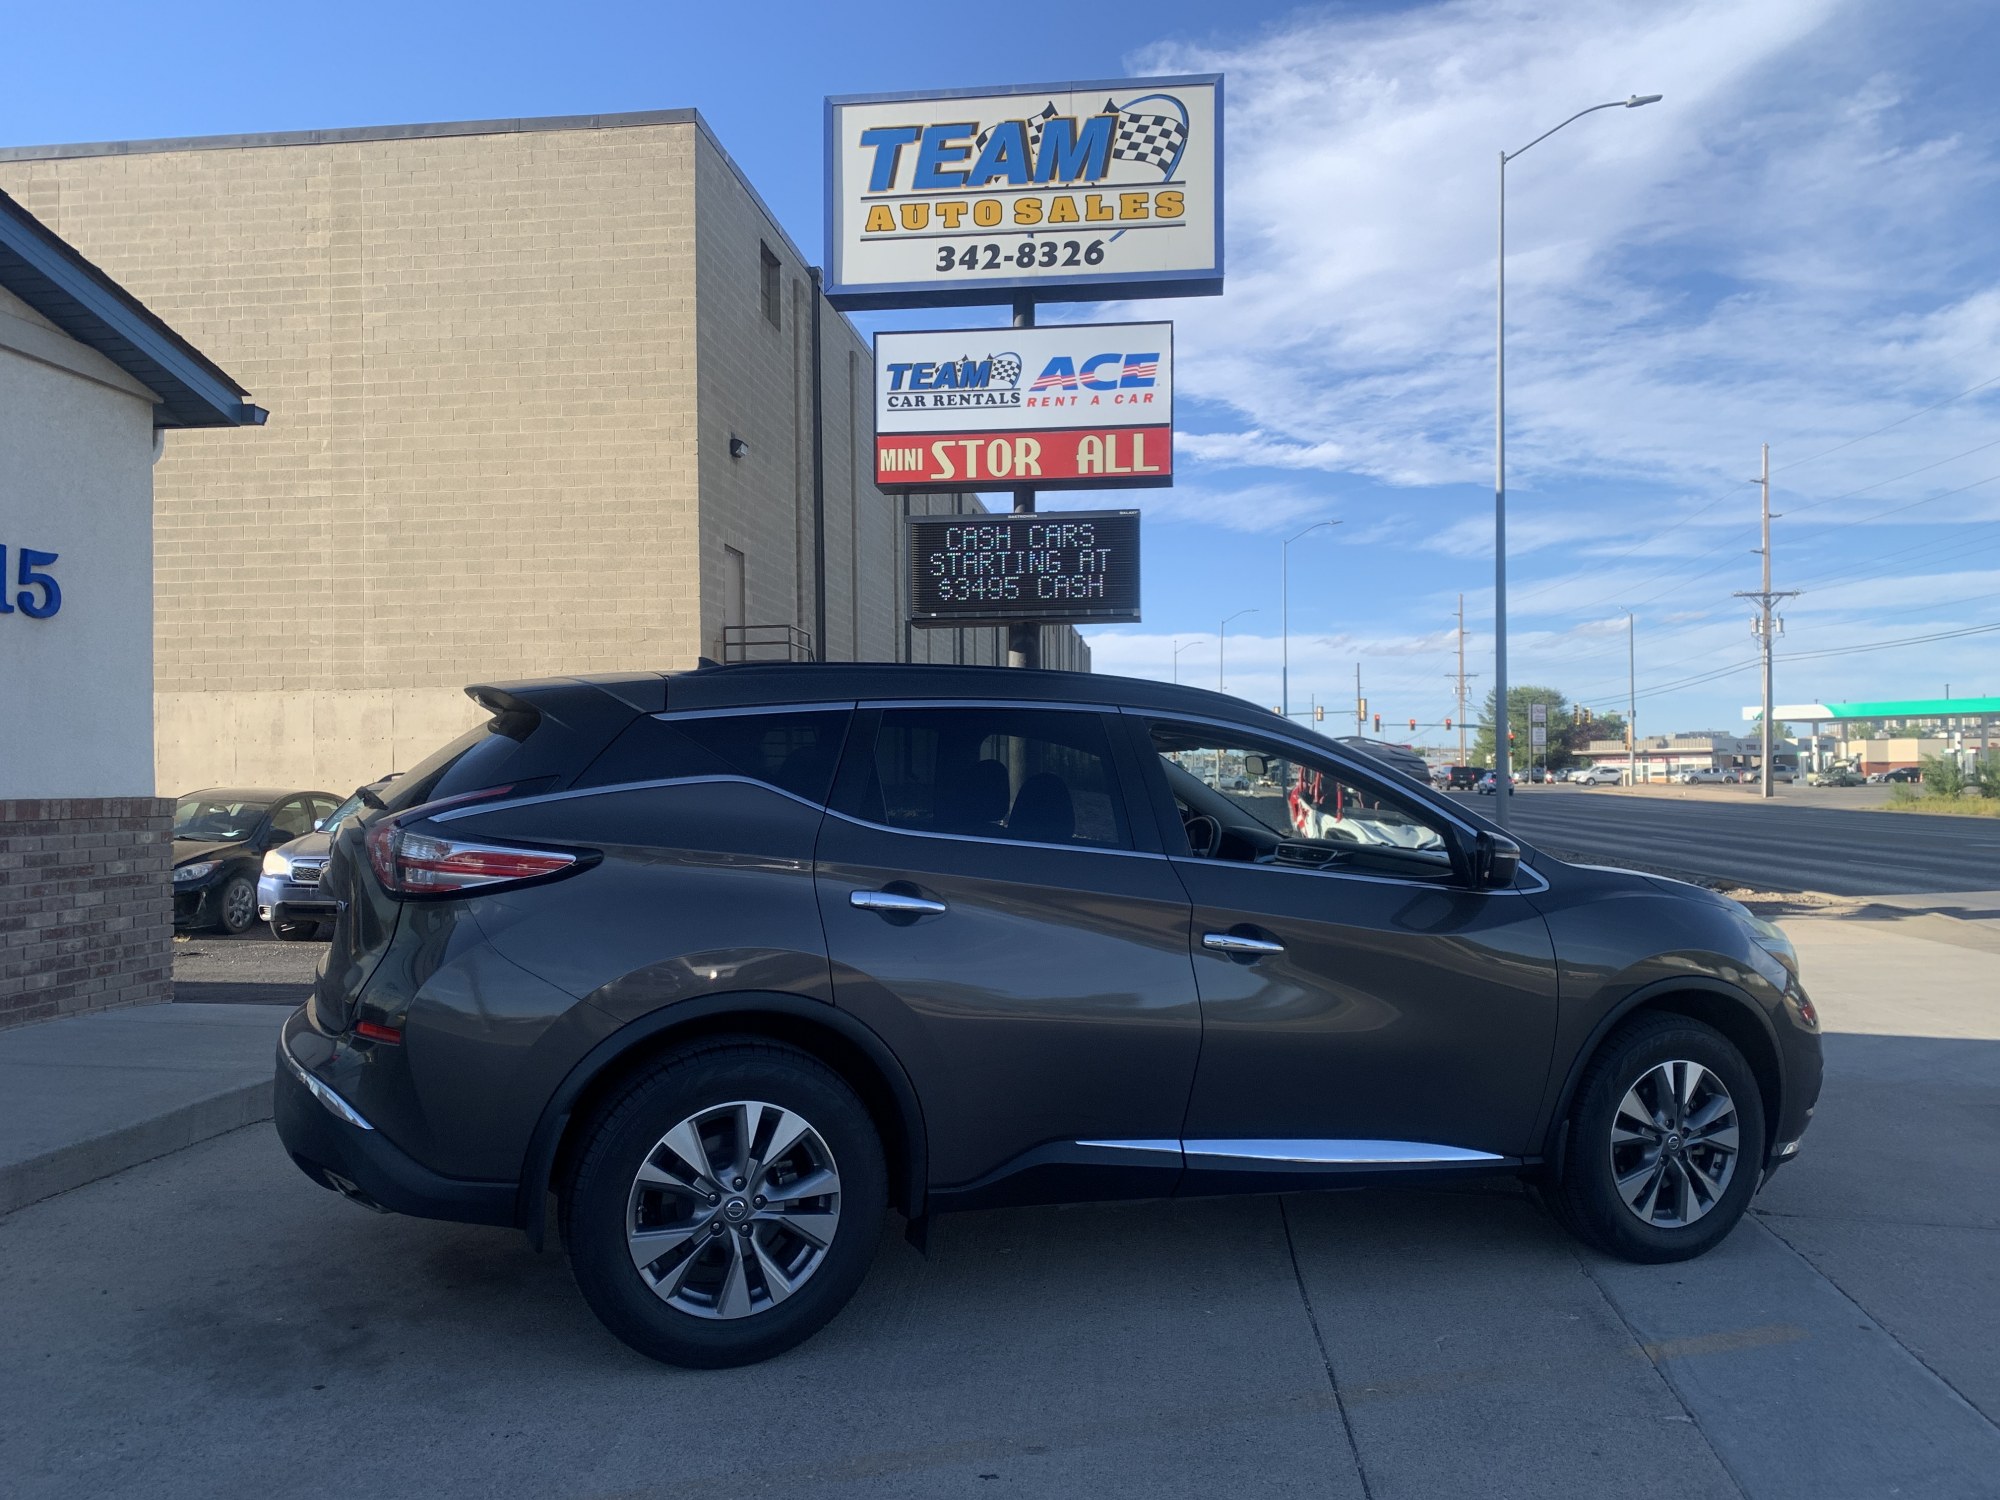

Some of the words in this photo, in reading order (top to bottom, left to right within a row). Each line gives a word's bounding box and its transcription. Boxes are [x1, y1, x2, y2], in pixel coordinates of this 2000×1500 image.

[859, 113, 1120, 193] TEAM
[936, 240, 1104, 271] 342-8326
[886, 359, 991, 391] TEAM
[1028, 352, 1160, 392] ACE
[887, 394, 927, 408] CAR
[933, 392, 1021, 407] RENTALS
[1027, 396, 1077, 408] RENT
[1090, 394, 1100, 405] A
[1114, 393, 1154, 404] CAR
[880, 448, 922, 471] MINI
[930, 437, 1042, 480] STOR
[1076, 433, 1160, 474] ALL
[946, 526, 1011, 550] CASH
[1029, 523, 1095, 548] CARS
[930, 550, 1061, 576] STARTING
[1079, 548, 1112, 573] AT
[938, 576, 1020, 601] $3495
[1037, 574, 1104, 599] CASH
